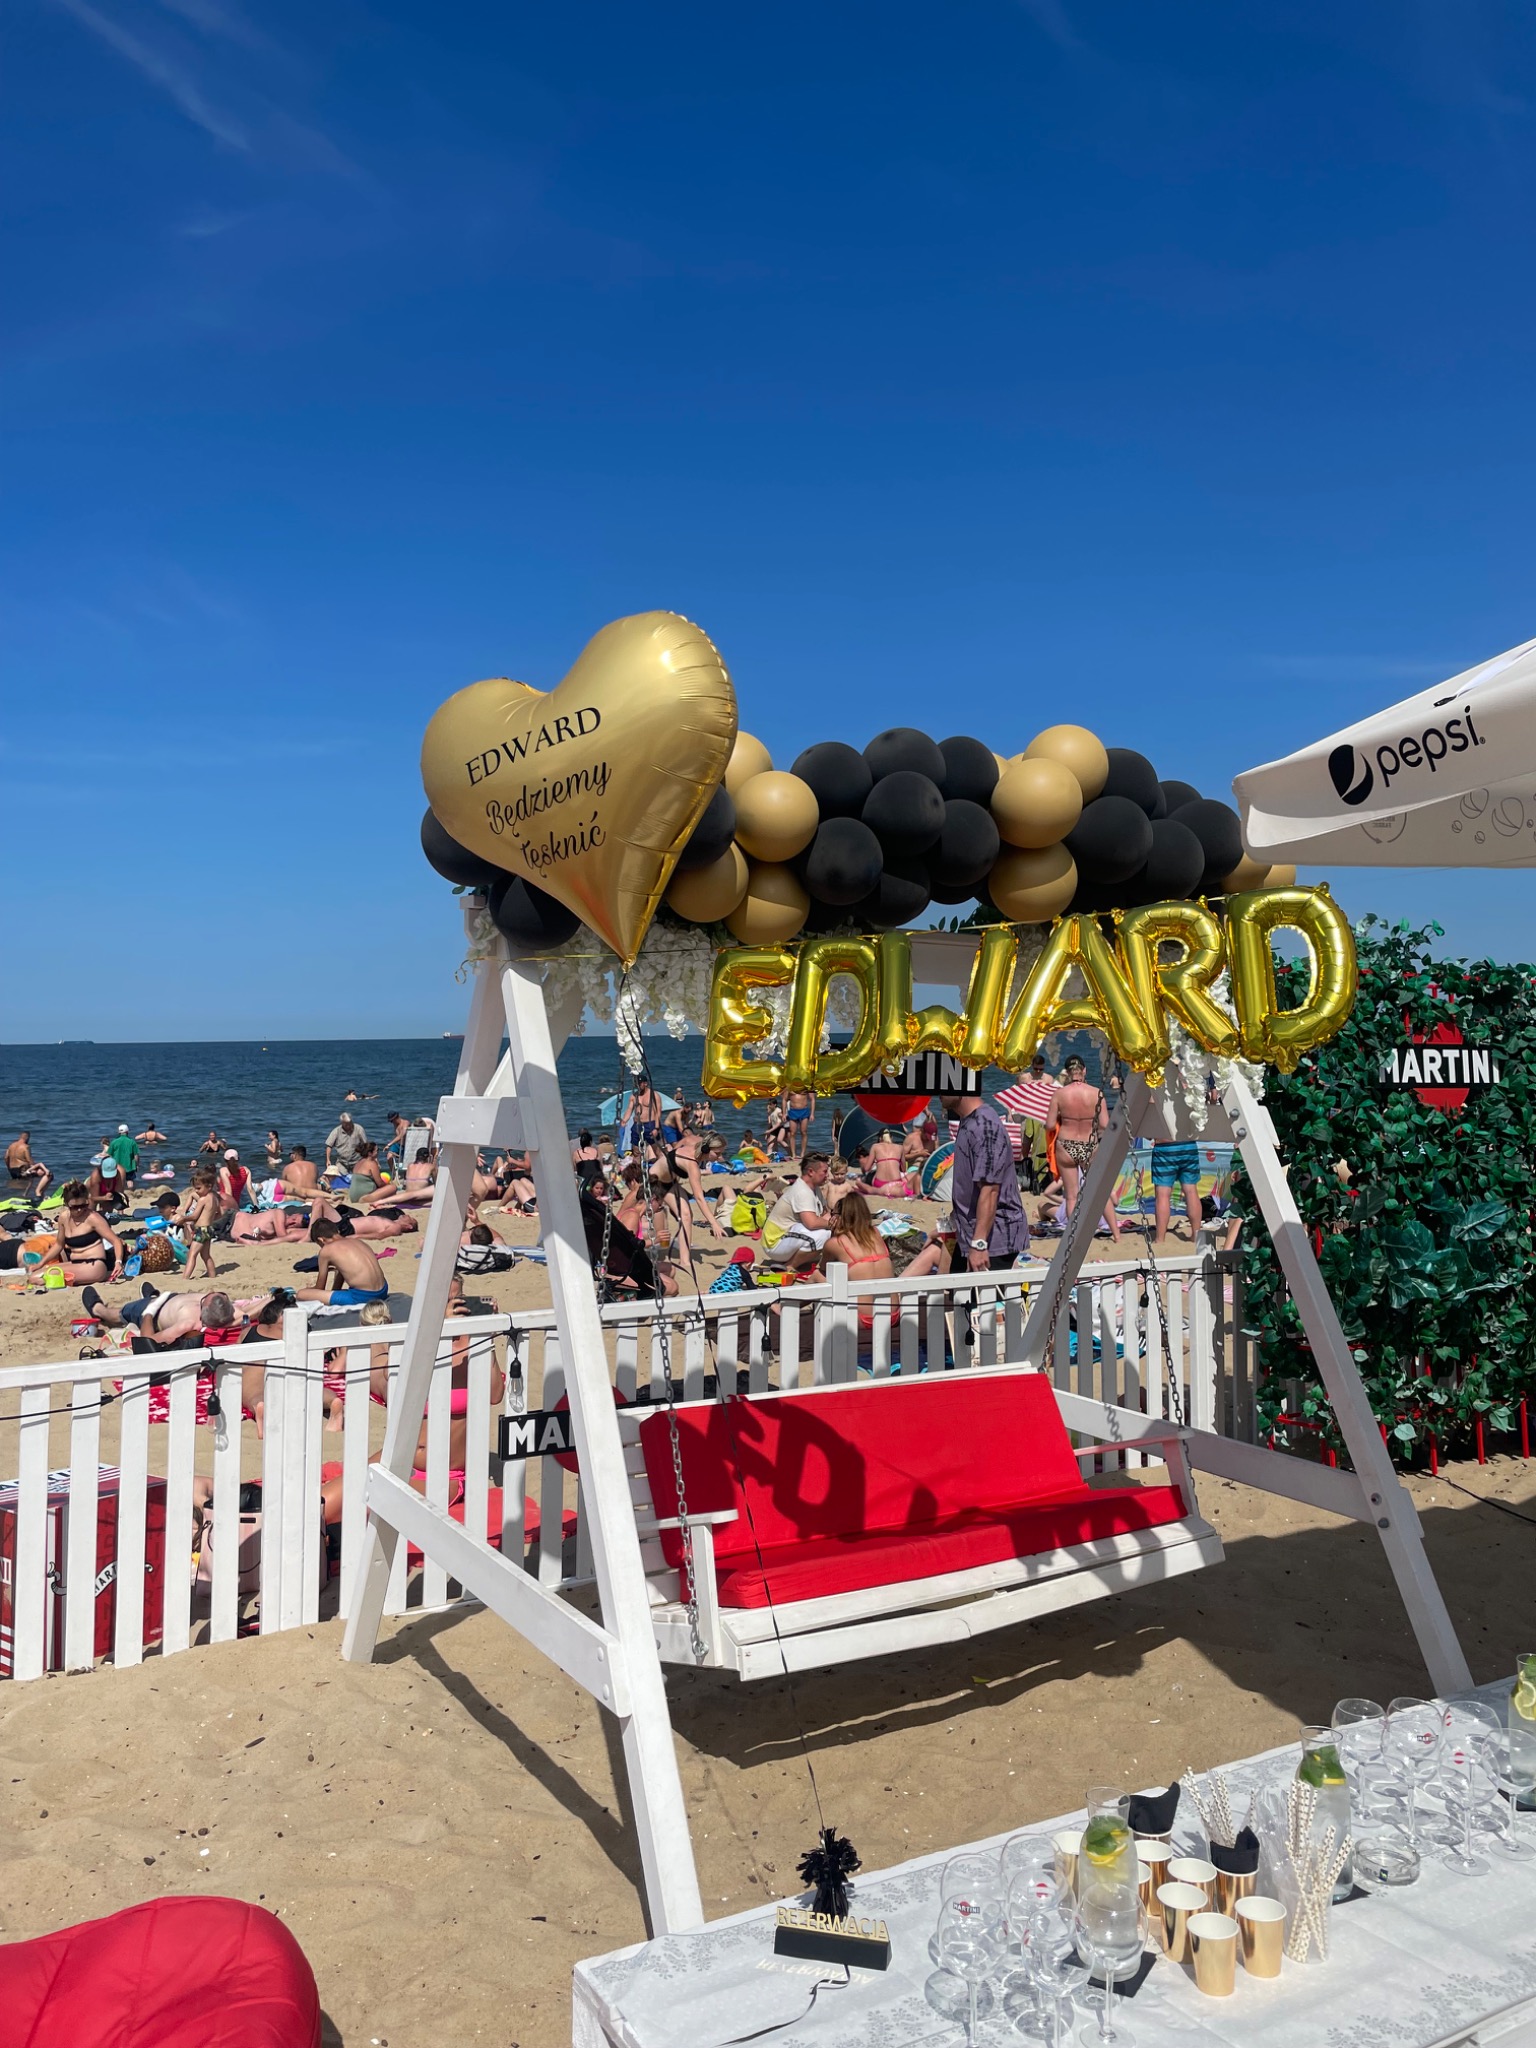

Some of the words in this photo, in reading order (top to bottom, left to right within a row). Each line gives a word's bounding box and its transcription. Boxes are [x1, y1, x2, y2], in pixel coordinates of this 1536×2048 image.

[464, 706, 601, 787] EDWARD
[486, 761, 612, 838] Będziemy
[702, 882, 1358, 1106] EDWARD
